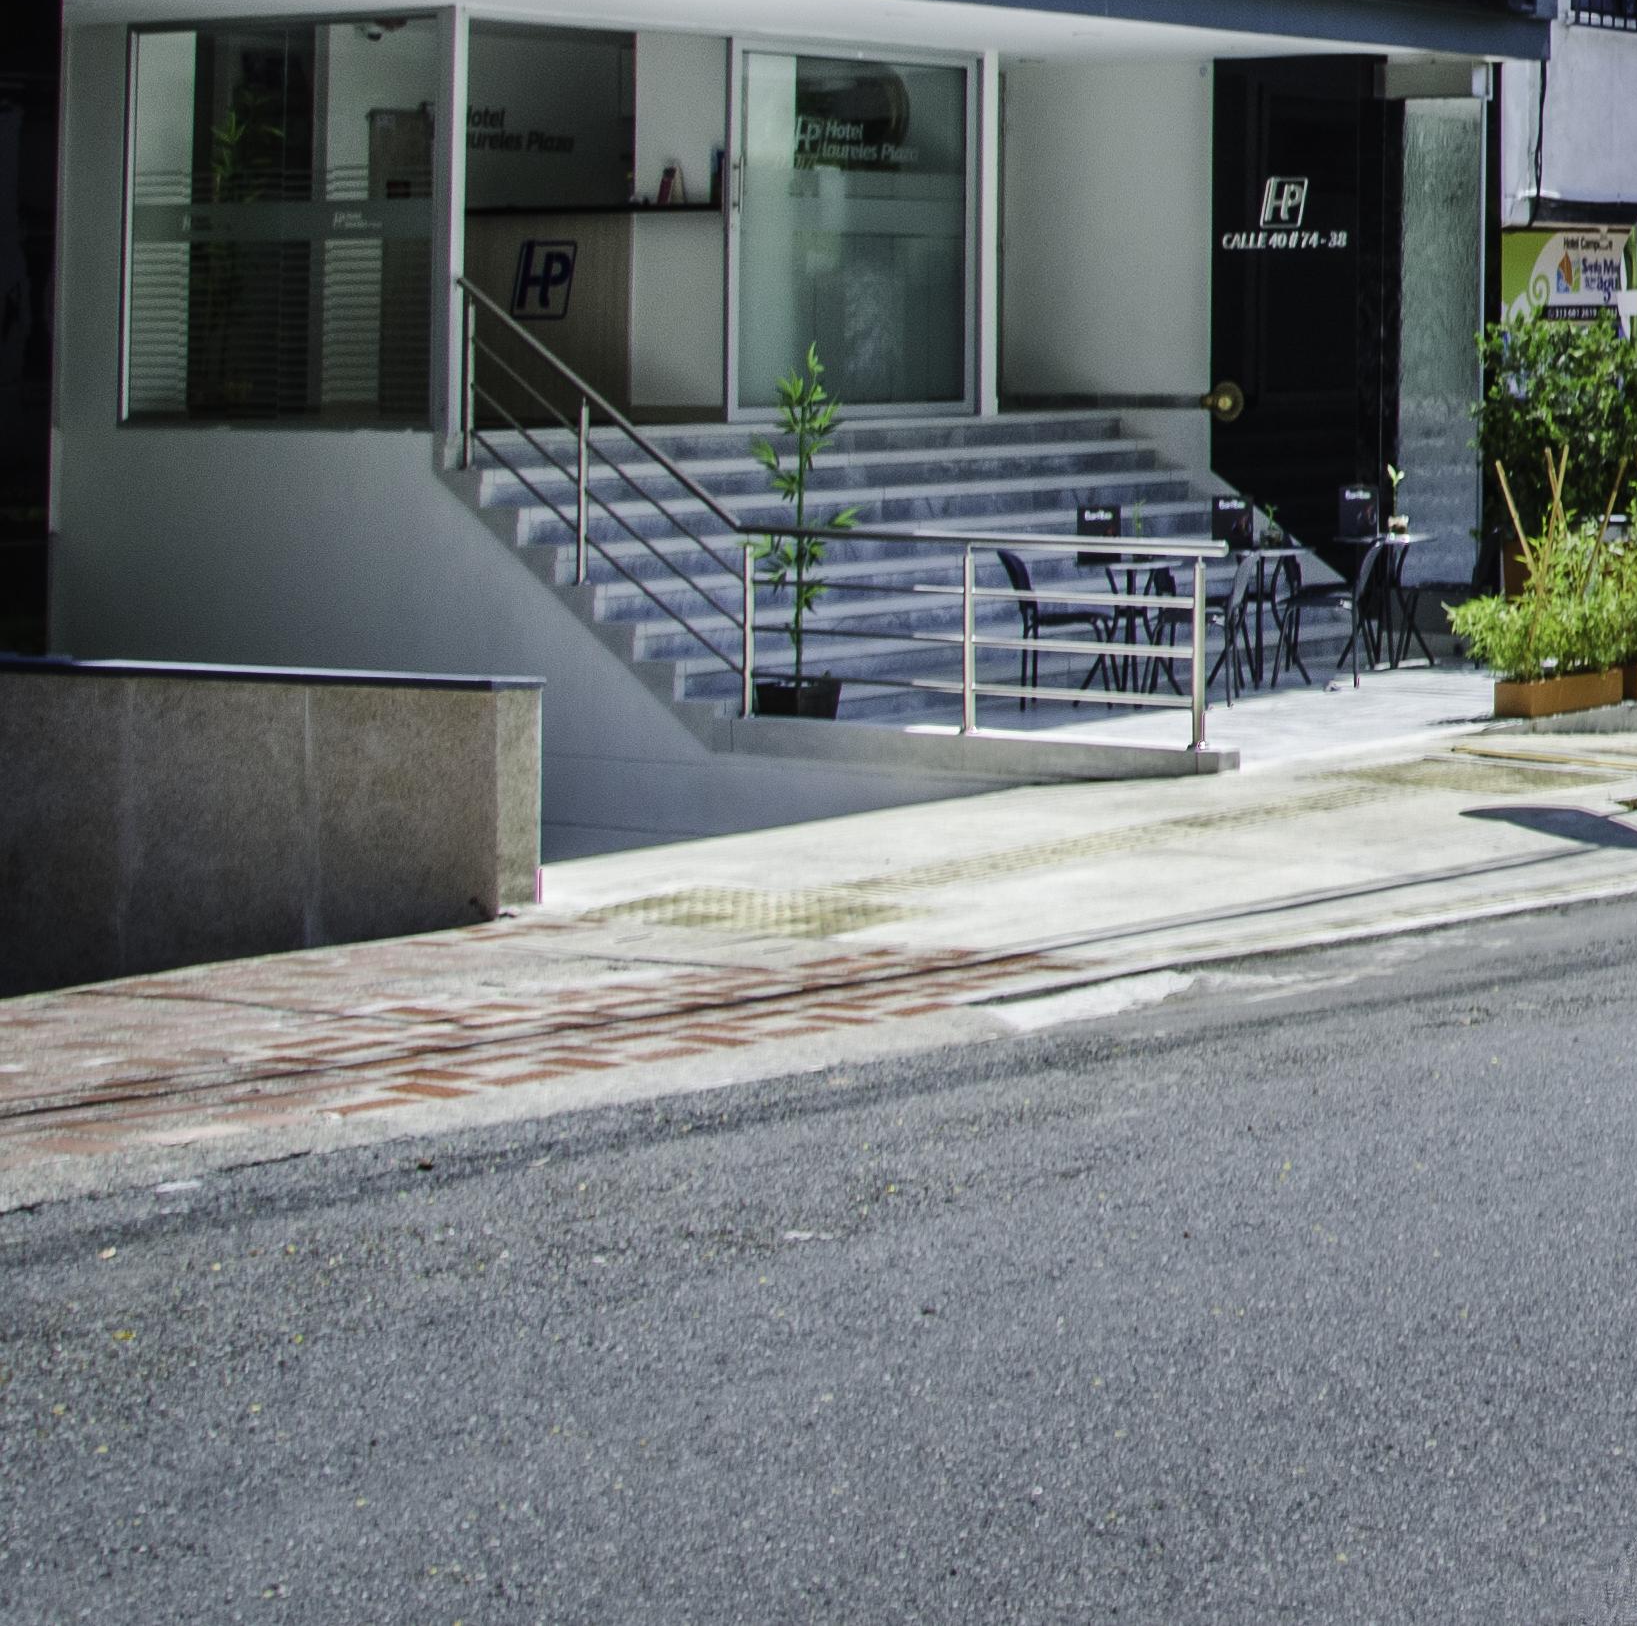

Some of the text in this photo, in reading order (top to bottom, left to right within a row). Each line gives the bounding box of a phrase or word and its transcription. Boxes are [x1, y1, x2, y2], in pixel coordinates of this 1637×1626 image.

[1221, 231, 1267, 250] CALLE
[1268, 231, 1287, 249] 40
[1300, 230, 1319, 249] 74
